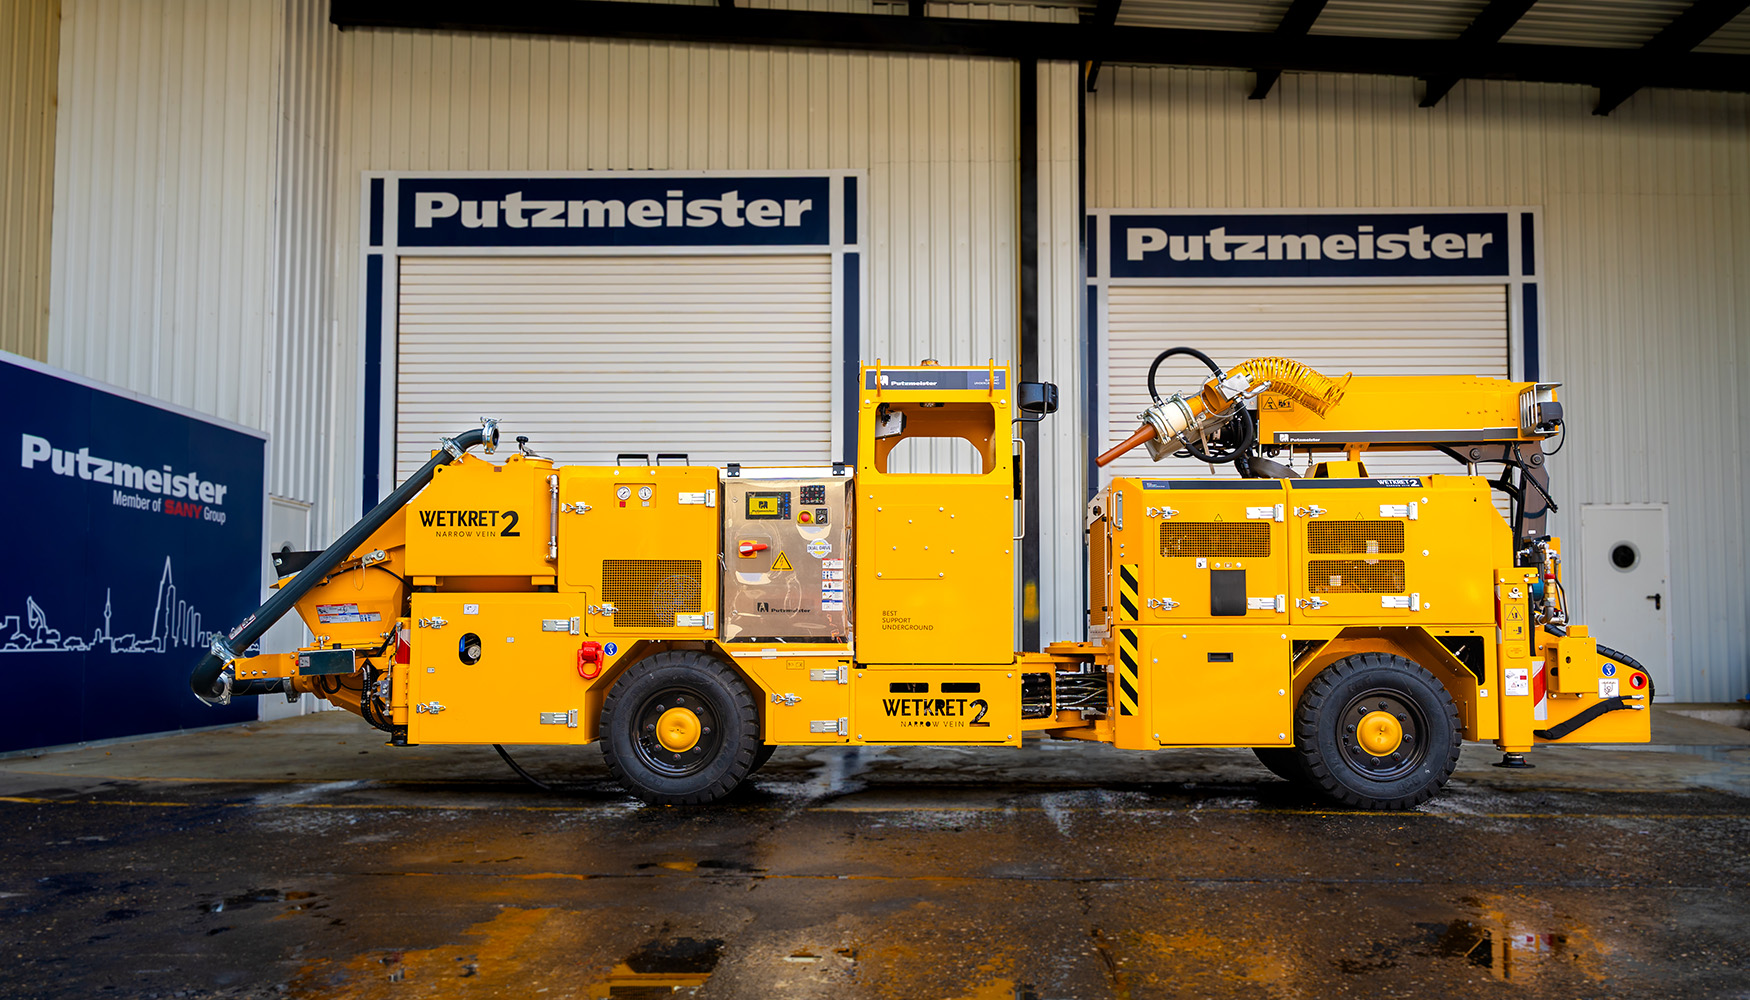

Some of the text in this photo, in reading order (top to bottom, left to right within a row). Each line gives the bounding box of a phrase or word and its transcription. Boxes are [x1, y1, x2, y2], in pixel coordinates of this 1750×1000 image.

[414, 189, 813, 229] Putzmeister
[1126, 225, 1493, 262] Putzmeister
[21, 433, 227, 505] Putzmeister
[1409, 479, 1420, 487] 2
[112, 489, 226, 525] Member of SANY Group
[419, 510, 520, 537] WETKRET 2
[882, 698, 990, 727] WETKRET 2
[900, 720, 965, 728] NARROW VEIN
